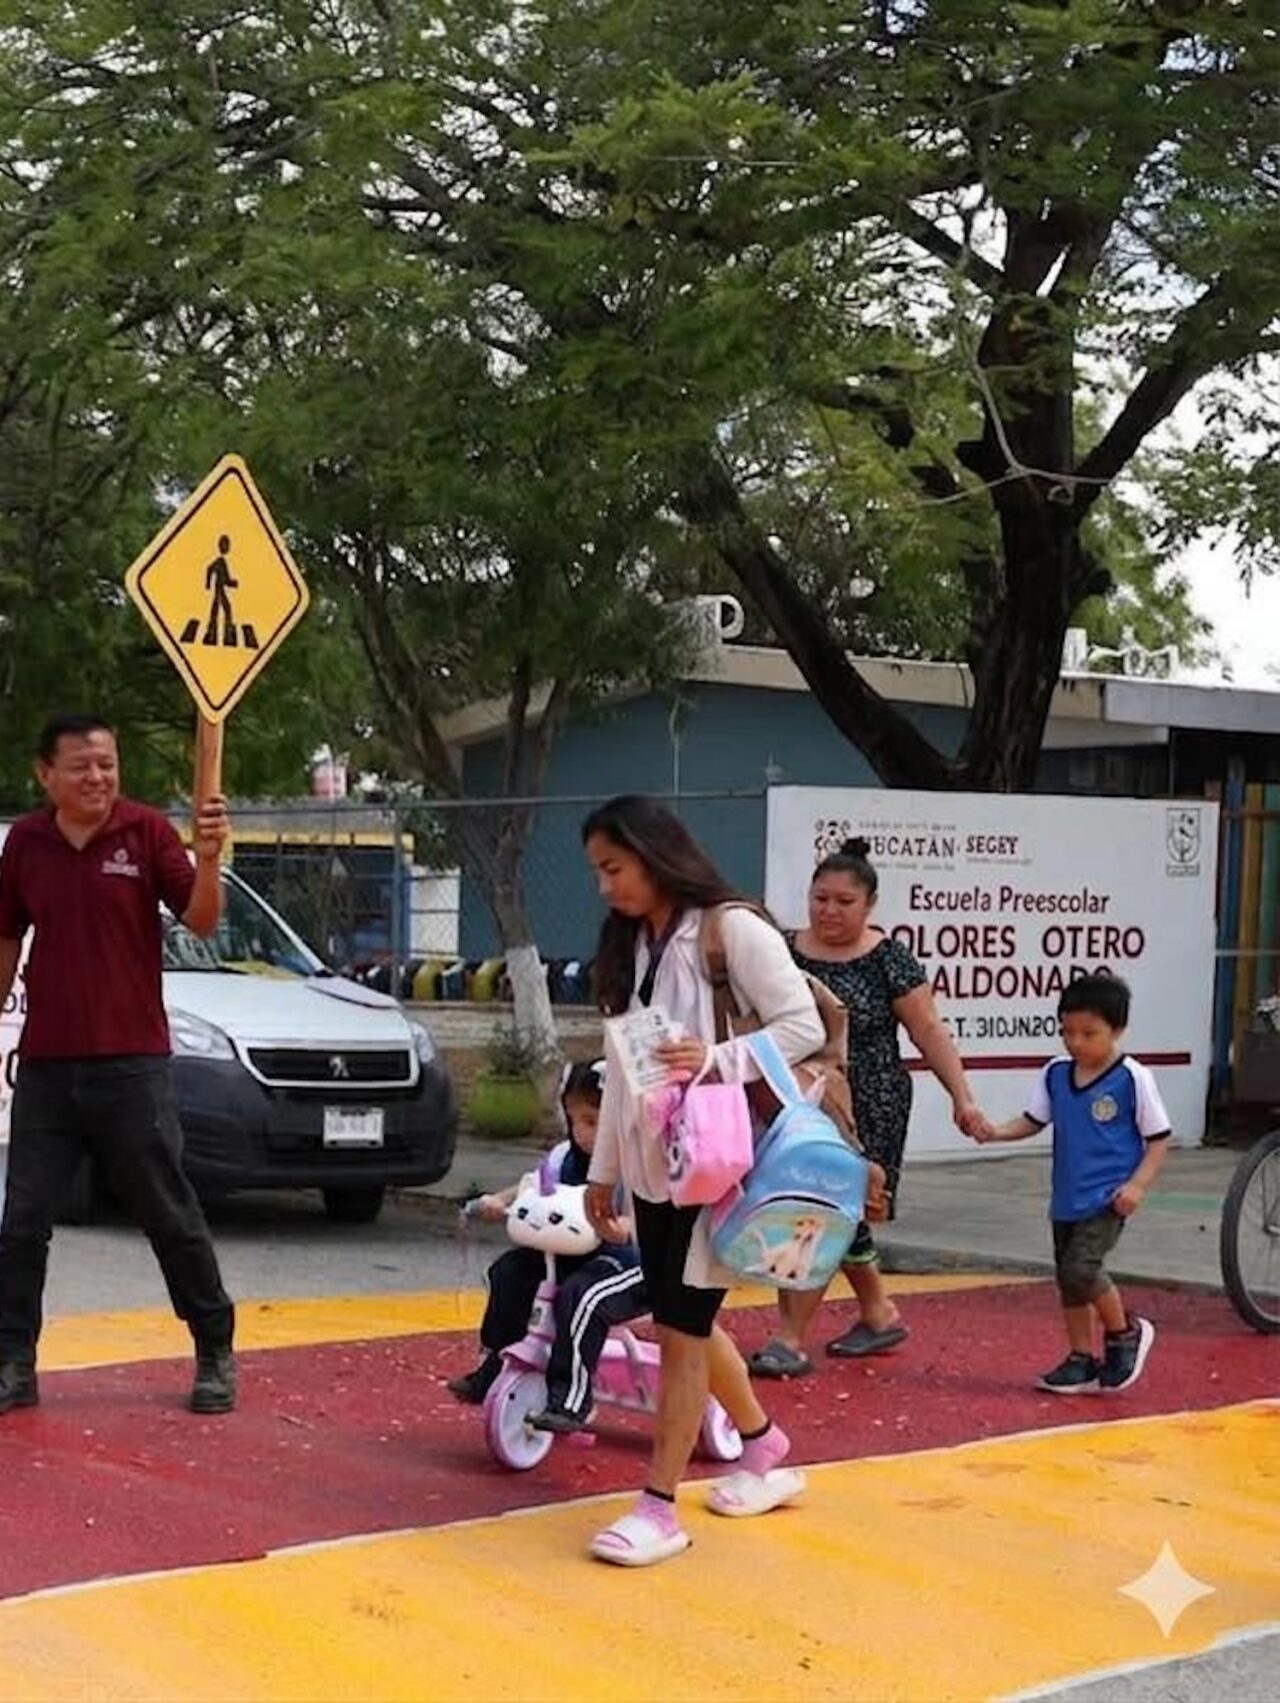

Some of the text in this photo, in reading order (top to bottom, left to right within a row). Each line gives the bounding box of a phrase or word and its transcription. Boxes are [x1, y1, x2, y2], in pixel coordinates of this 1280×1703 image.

[965, 834, 1019, 855] SEGEY
[909, 884, 1111, 914] Escuela Preescolar
[868, 924, 1146, 959] OLORES OTERO
